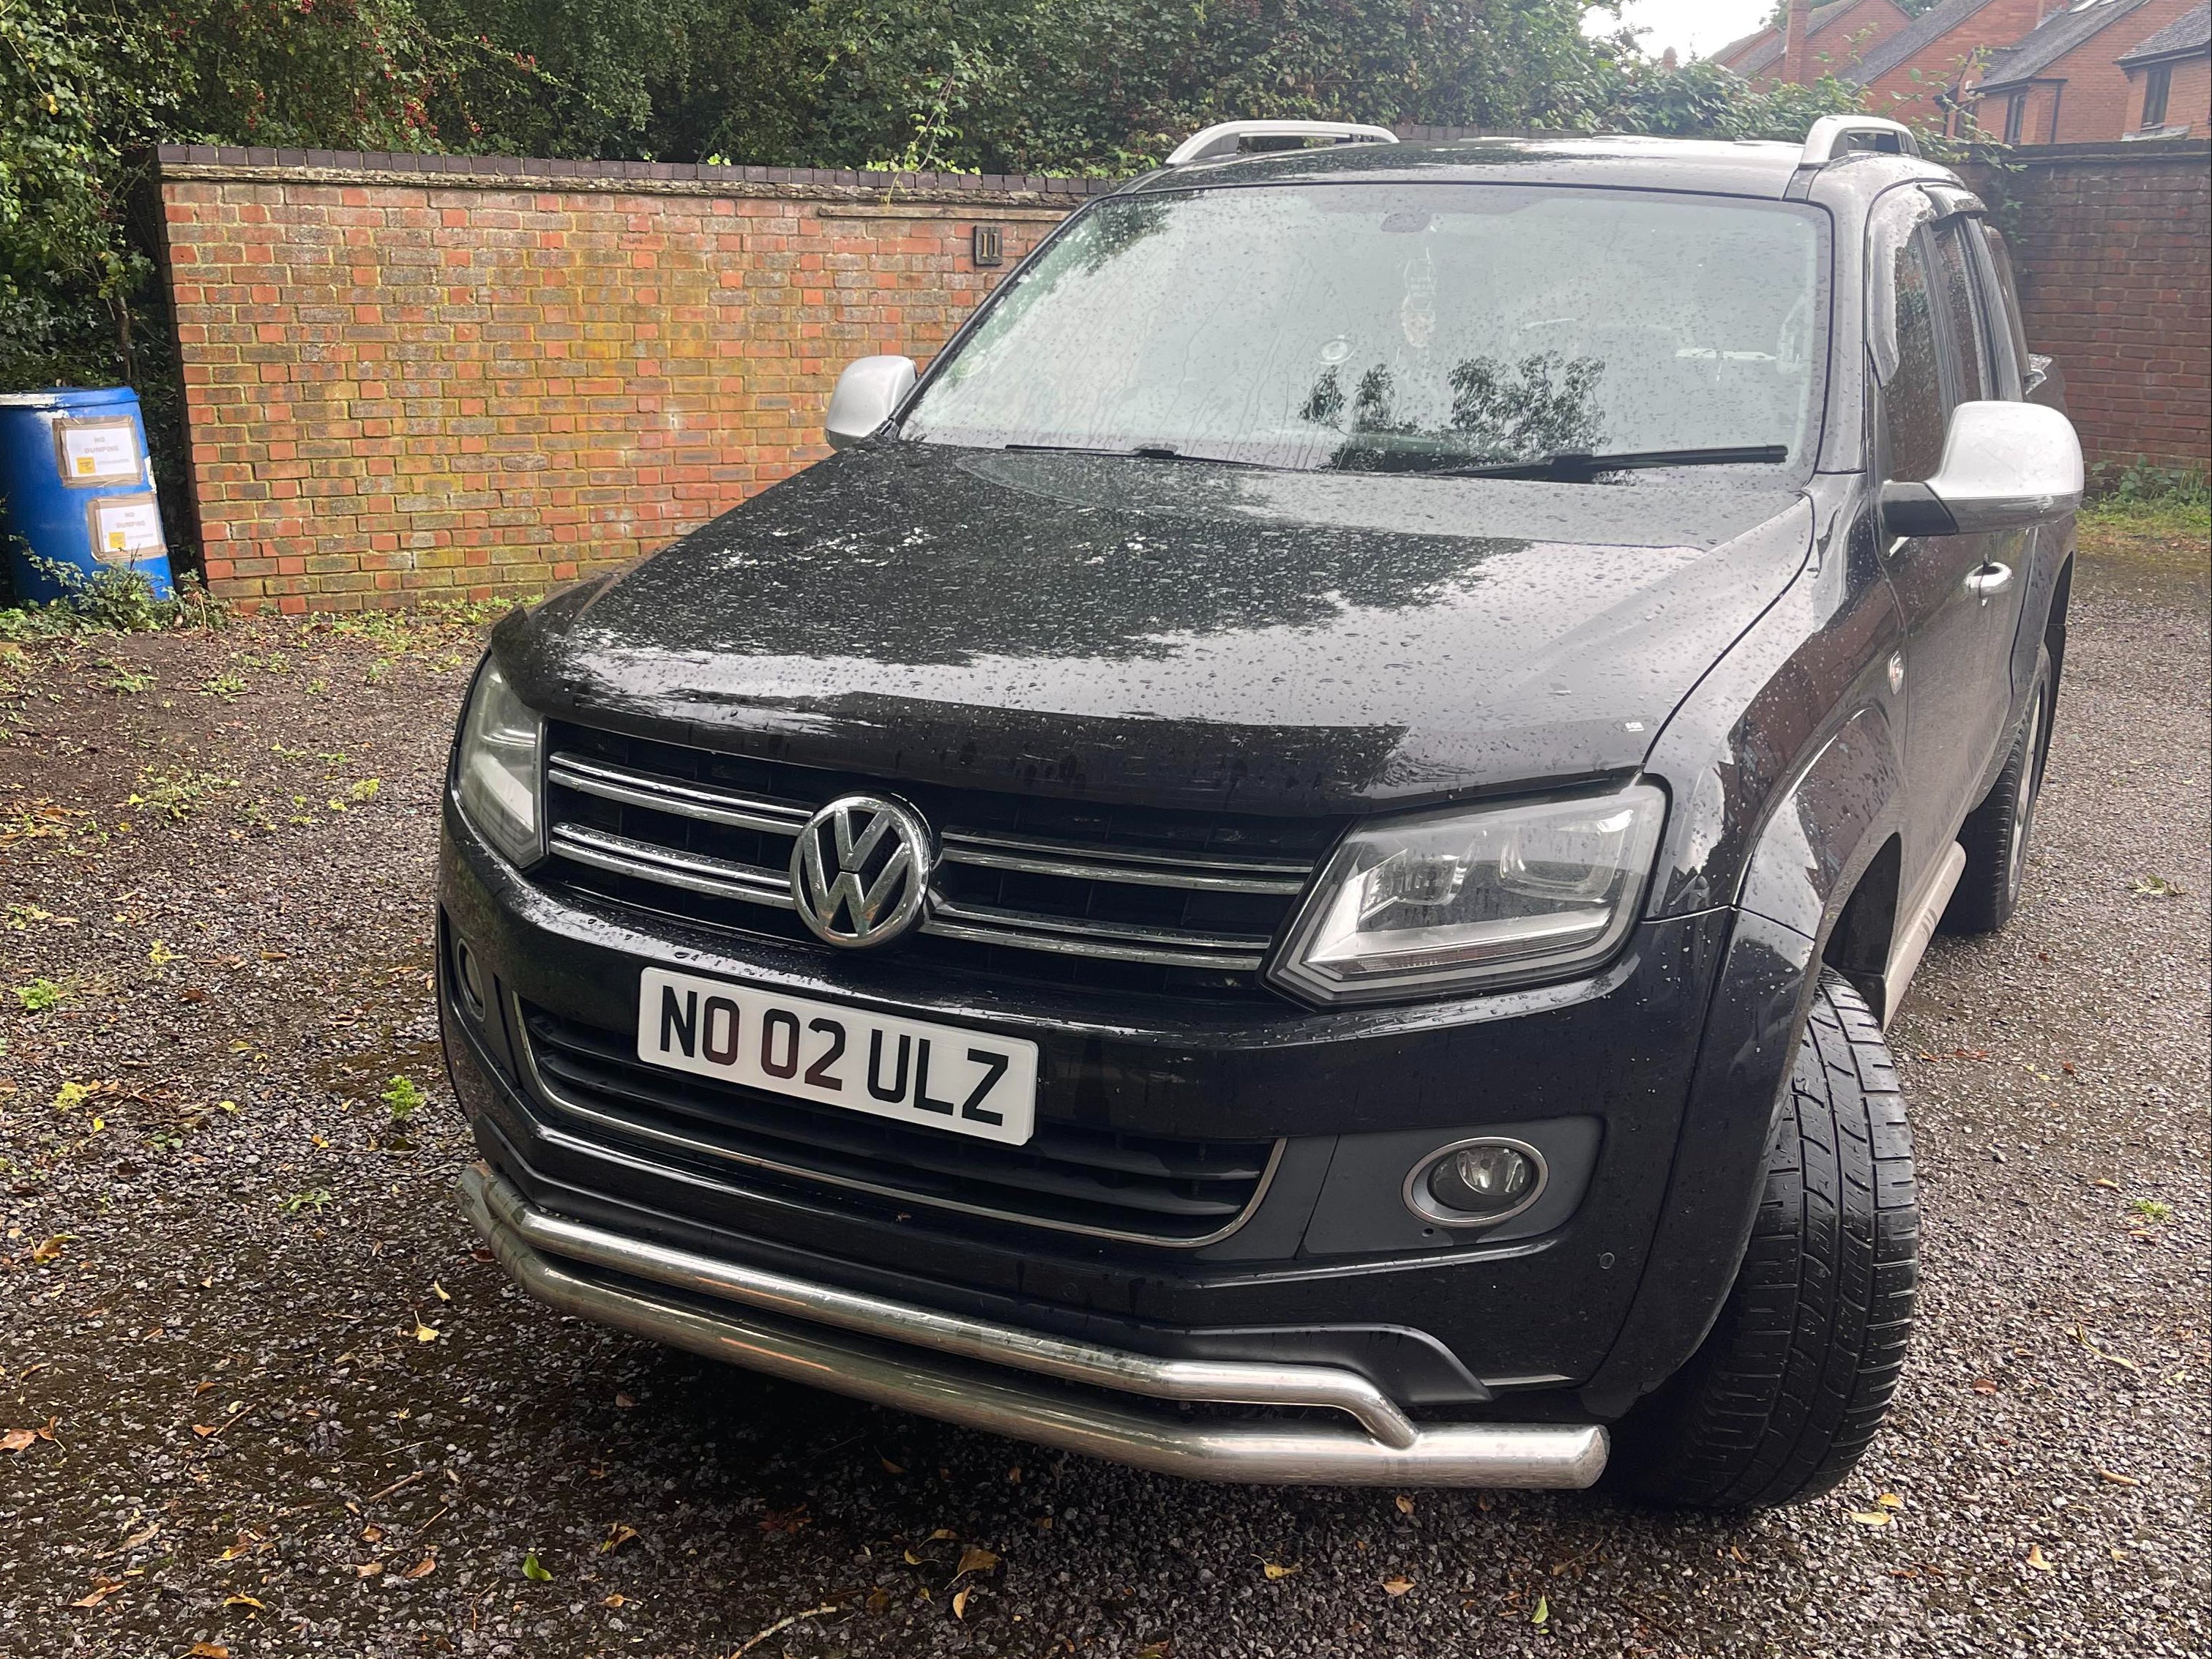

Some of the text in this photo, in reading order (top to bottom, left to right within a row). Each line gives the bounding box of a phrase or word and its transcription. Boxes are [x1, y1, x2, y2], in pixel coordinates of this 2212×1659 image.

[982, 233, 999, 258] 11
[660, 984, 1009, 1127] NO 02 ULZ
